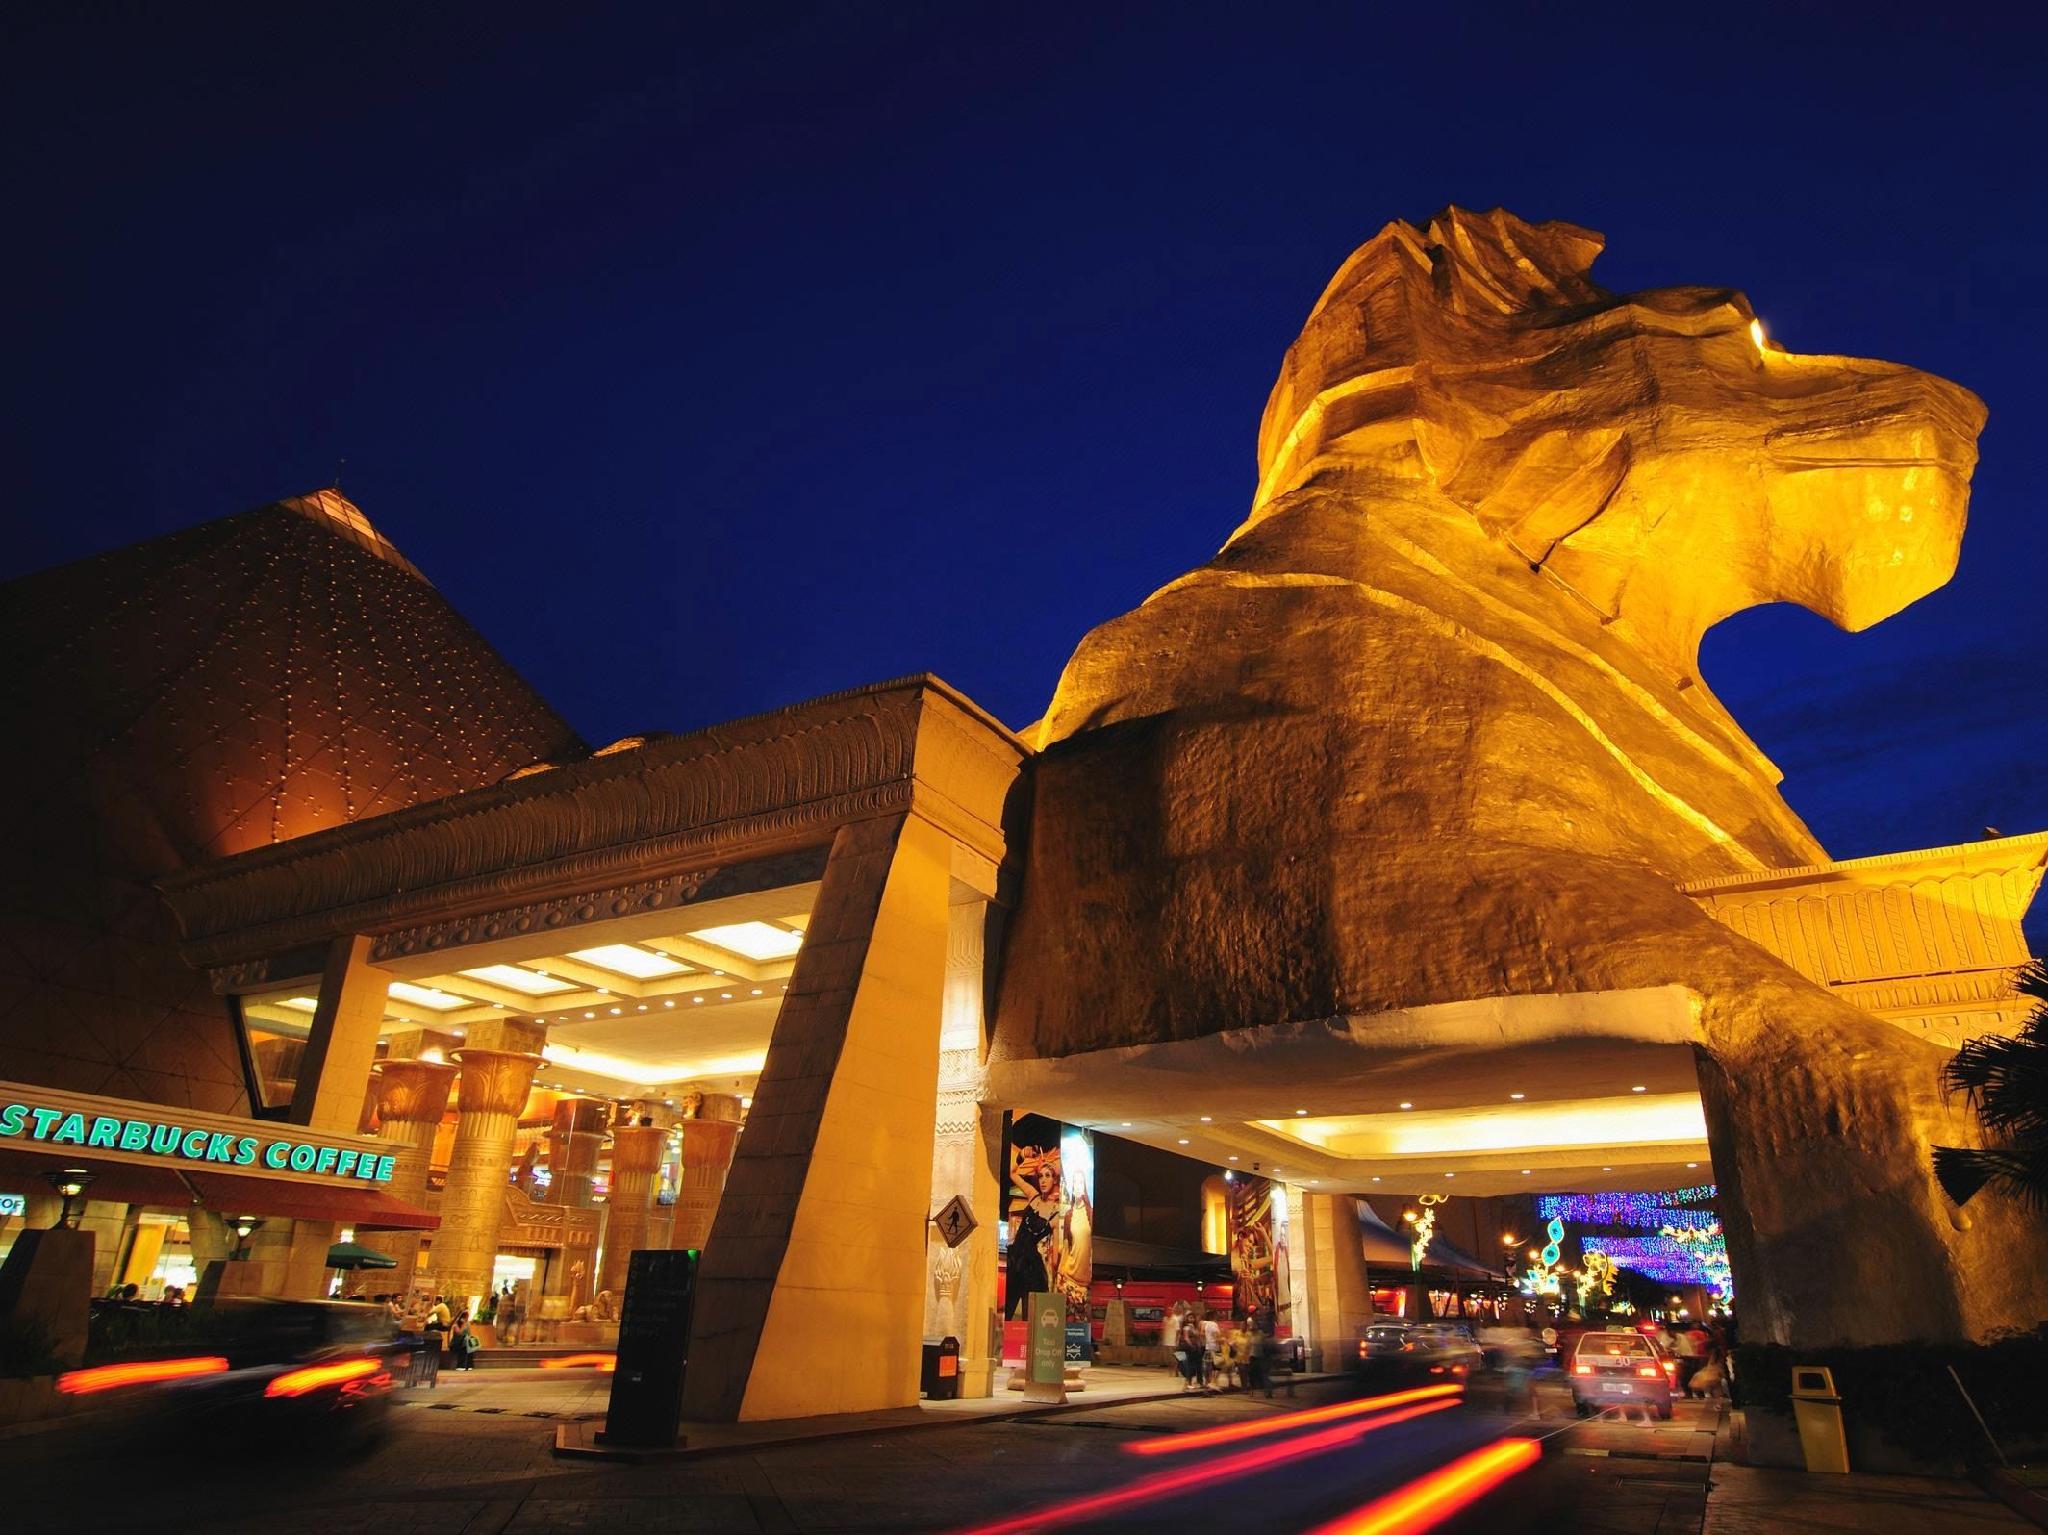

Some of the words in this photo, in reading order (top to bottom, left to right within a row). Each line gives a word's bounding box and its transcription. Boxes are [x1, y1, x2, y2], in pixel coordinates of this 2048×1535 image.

[0, 1104, 259, 1165] STARBUCKS
[266, 1141, 396, 1181] COFFEE
[0, 1198, 23, 1209] OF
